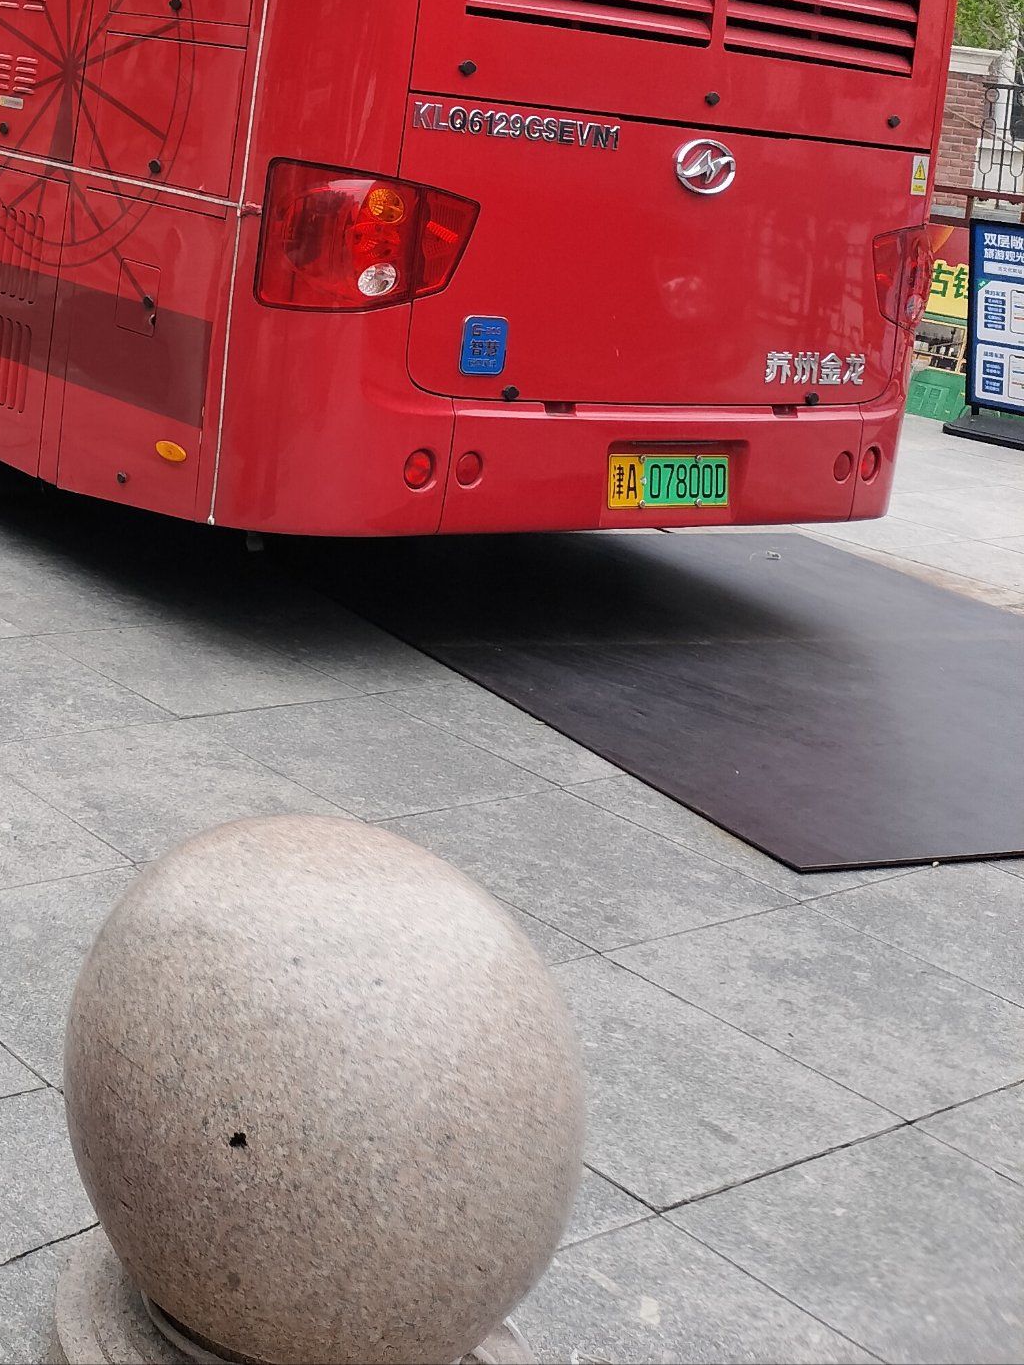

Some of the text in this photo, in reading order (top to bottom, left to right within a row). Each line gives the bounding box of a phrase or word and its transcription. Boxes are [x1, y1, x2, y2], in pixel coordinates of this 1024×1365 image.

[412, 101, 621, 150] KLQ6129GSEVN1
[983, 247, 1024, 264] 旅游观光
[469, 338, 501, 356] 智慧
[765, 351, 865, 386] 苏州金龙
